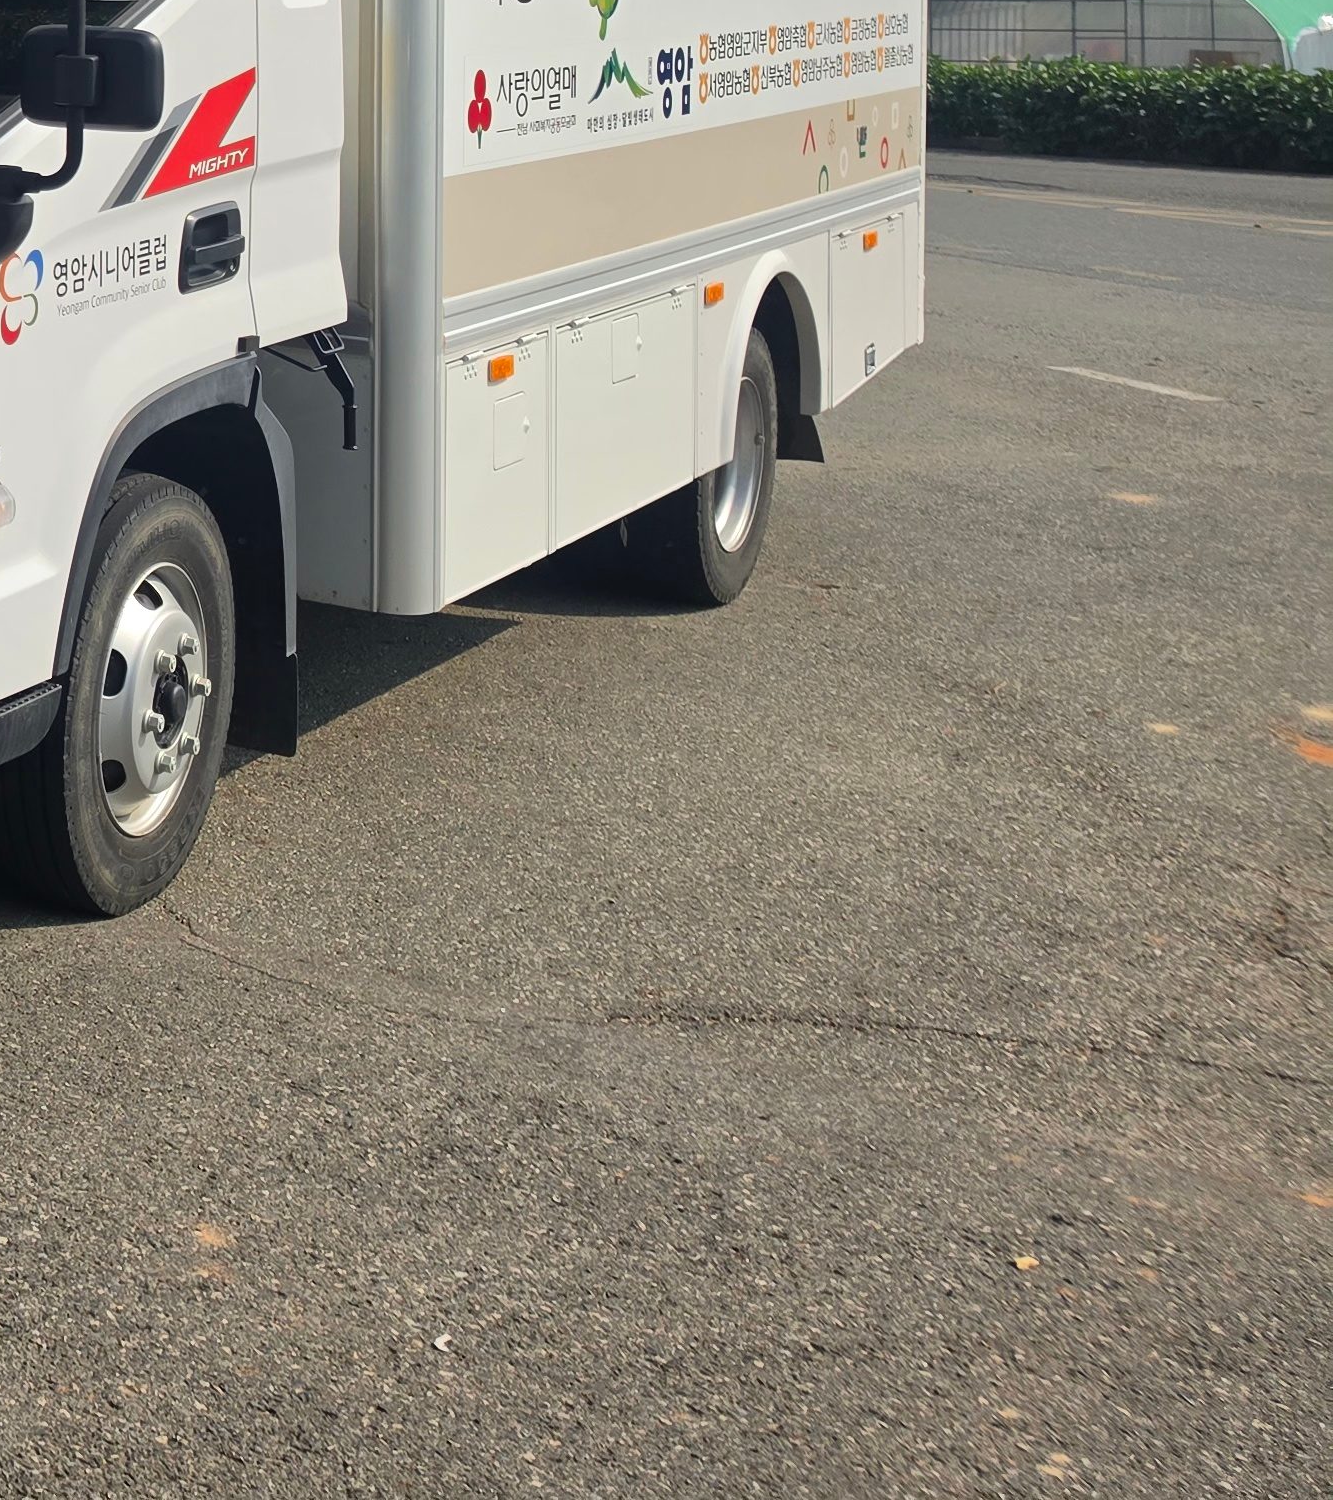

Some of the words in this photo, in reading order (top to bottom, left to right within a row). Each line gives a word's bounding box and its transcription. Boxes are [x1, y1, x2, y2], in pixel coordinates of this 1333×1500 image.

[709, 30, 768, 61] 농협영암군지부
[777, 24, 808, 53] 영암축협
[815, 20, 844, 46] 군서농협
[851, 16, 877, 42] 금정농협
[496, 65, 577, 118] 사랑의열매
[656, 46, 694, 119] 영암
[708, 67, 751, 99] 서영암농협
[760, 62, 792, 90] 신북농협
[851, 47, 877, 75] 영암농협
[516, 122, 528, 137] 전남
[529, 114, 577, 135] 사회복지공동모금회
[587, 115, 605, 133] 마한의
[188, 147, 249, 180] MIGHTY
[53, 234, 168, 298] 영암시니어클럽
[57, 298, 90, 318] Yeongam
[91, 287, 129, 309] Community
[130, 282, 151, 298] Senior
[152, 278, 167, 292] Club
